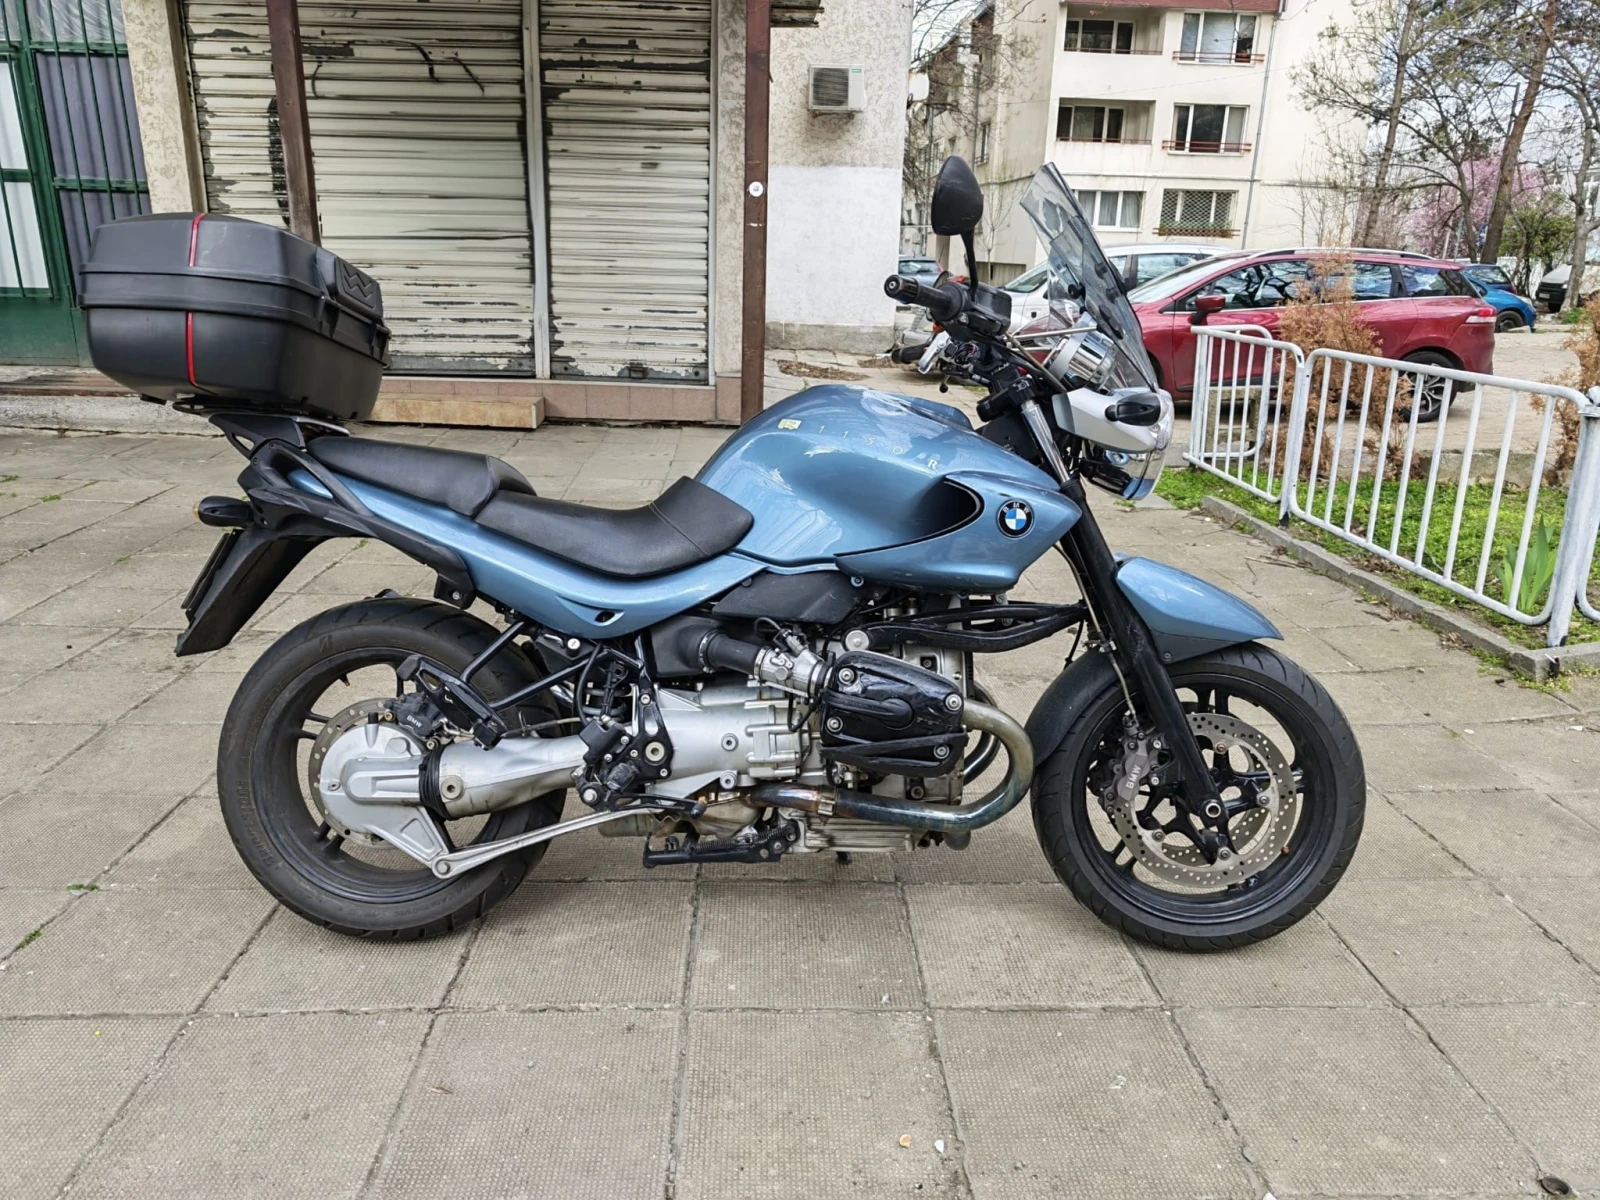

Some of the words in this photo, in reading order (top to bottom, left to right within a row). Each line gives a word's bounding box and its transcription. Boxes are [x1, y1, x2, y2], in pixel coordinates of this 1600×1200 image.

[927, 458, 939, 470] R
[1002, 502, 1031, 514] BMW
[406, 714, 423, 728] BMW
[1125, 764, 1142, 789] BMW
